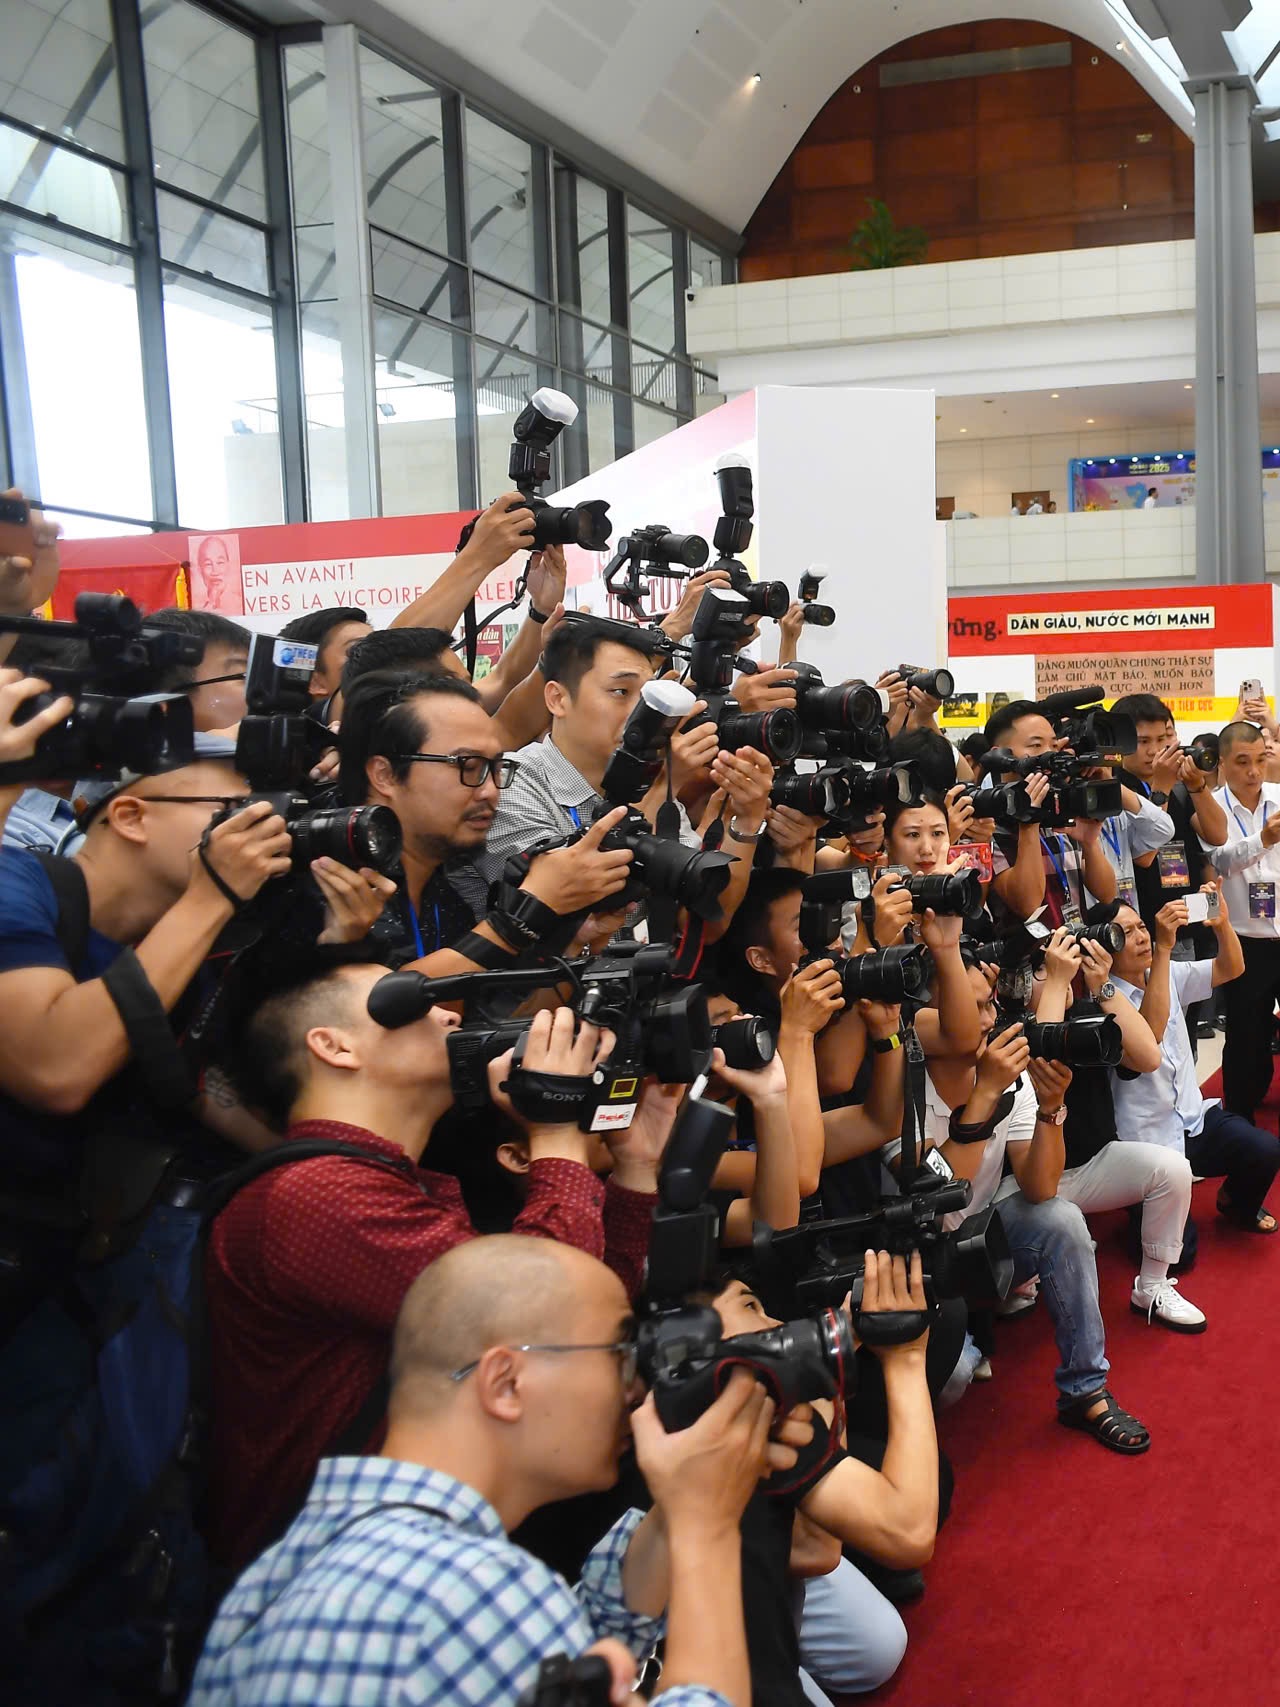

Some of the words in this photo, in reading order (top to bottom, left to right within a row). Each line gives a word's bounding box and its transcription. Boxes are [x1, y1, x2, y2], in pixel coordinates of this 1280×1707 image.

[1149, 462, 1171, 474] 2025
[244, 571, 269, 587] EN
[282, 562, 354, 585] AVANT!
[245, 594, 291, 613] VERS
[302, 594, 323, 610] LA
[334, 586, 423, 608] VICTOIRE
[948, 617, 1003, 642] ững.
[1011, 616, 1039, 630] DÂN
[1044, 613, 1081, 630] GIÀU,
[1085, 612, 1129, 627] NƯỚC
[1133, 610, 1161, 626] MỚI
[1167, 612, 1210, 628] MẠNH
[541, 1090, 587, 1102] SONY
